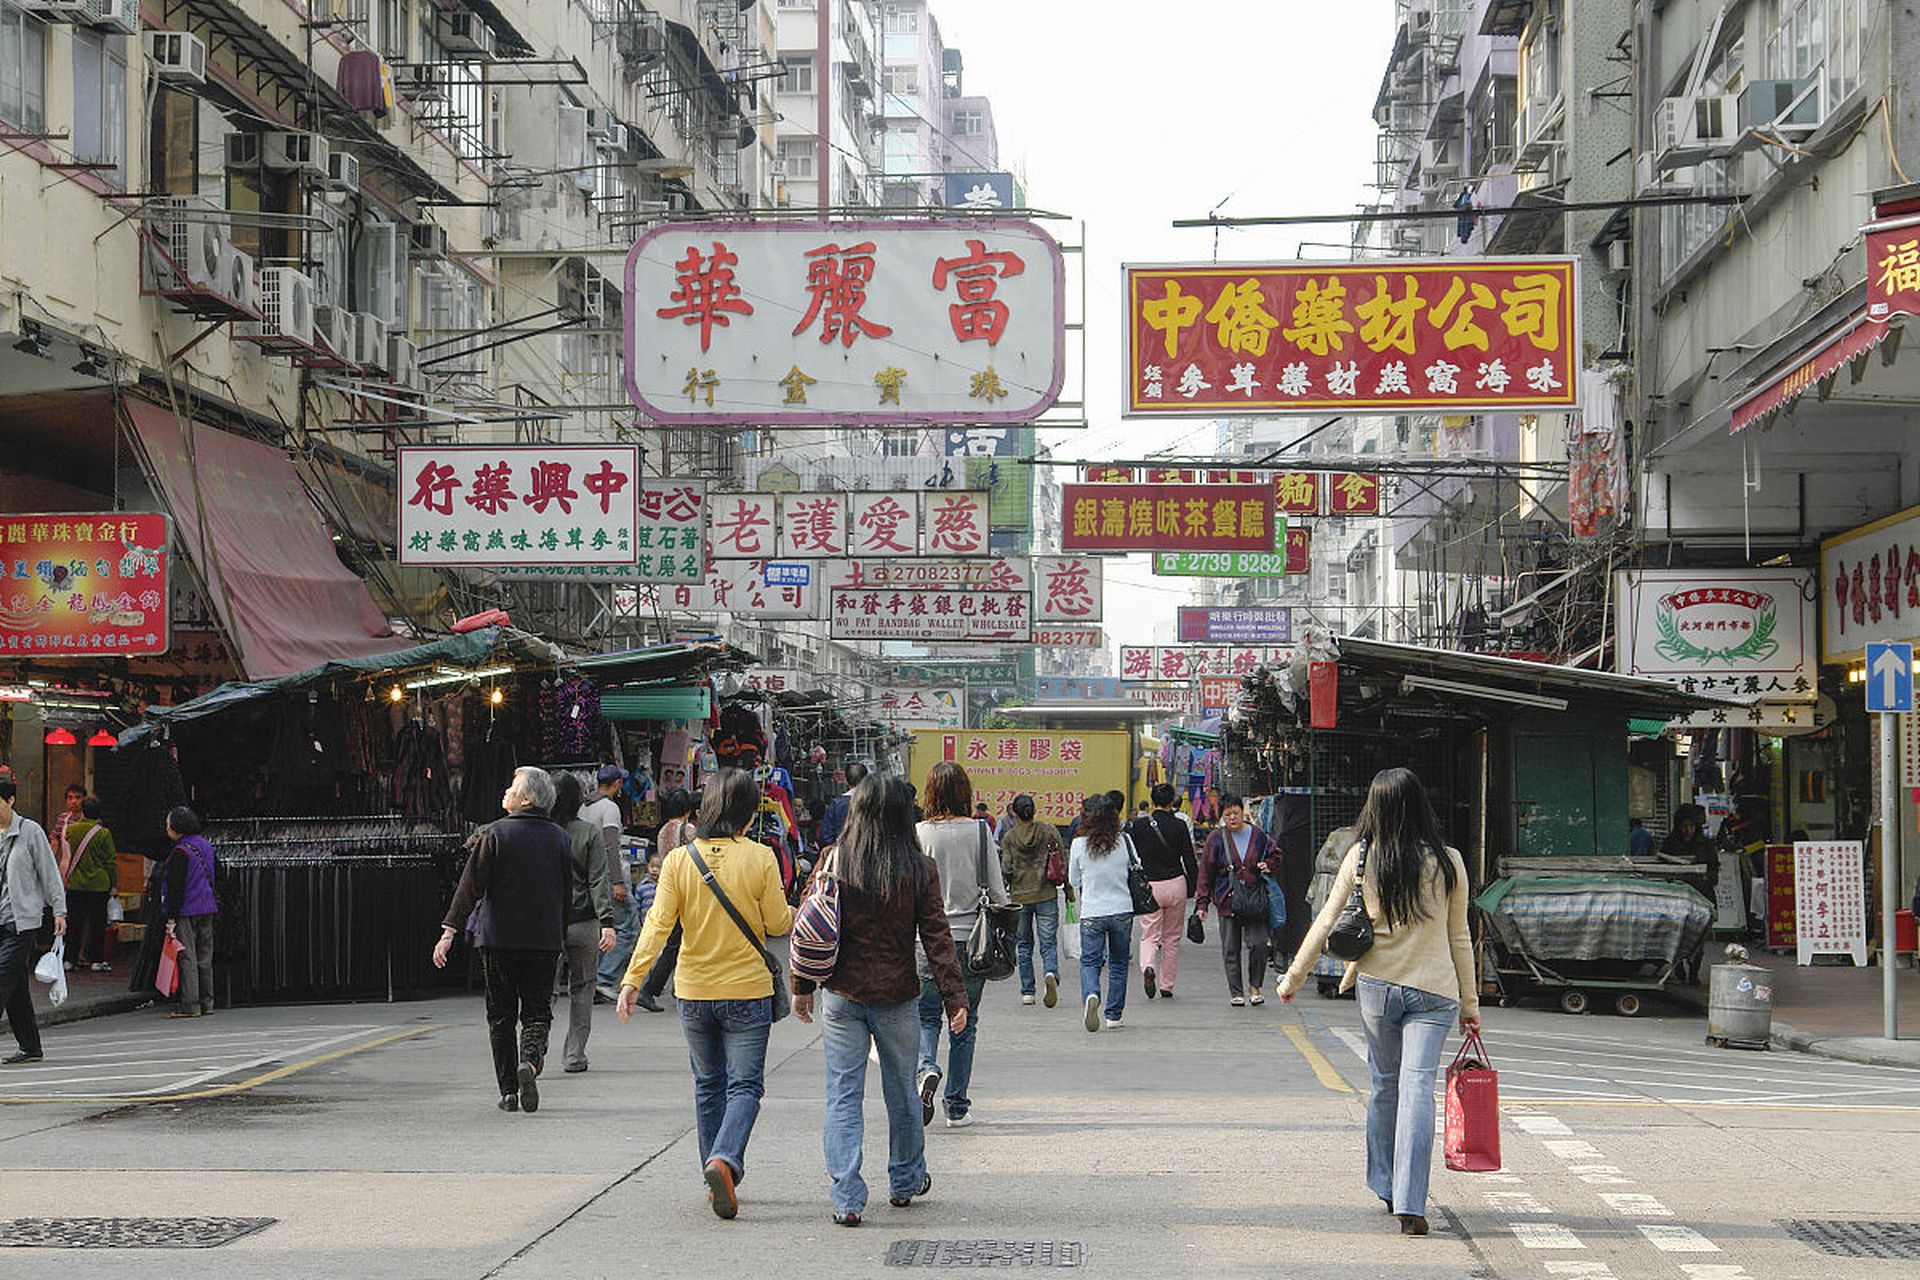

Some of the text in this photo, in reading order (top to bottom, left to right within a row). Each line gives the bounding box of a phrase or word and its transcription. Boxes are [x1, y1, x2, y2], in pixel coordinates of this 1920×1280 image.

[1875, 239, 1920, 296] 福
[656, 239, 1026, 353] 富麗華
[1142, 273, 1562, 359] 中僑藥材公司
[1176, 357, 1564, 399] 參茸藥材燕窩海味
[1071, 497, 1266, 539] 銀濤燒味茶餐廳
[0, 521, 139, 544] 麗華珠寶金行
[895, 564, 985, 582] 27082377
[1238, 553, 1282, 575] 8282
[835, 593, 1027, 617] 和發手袋銀包批發
[834, 618, 1027, 630] WO FAT HANDBAG WALLET WHOLESALE
[1151, 690, 1180, 702] KINDS
[967, 738, 1083, 761] 永達膠袋
